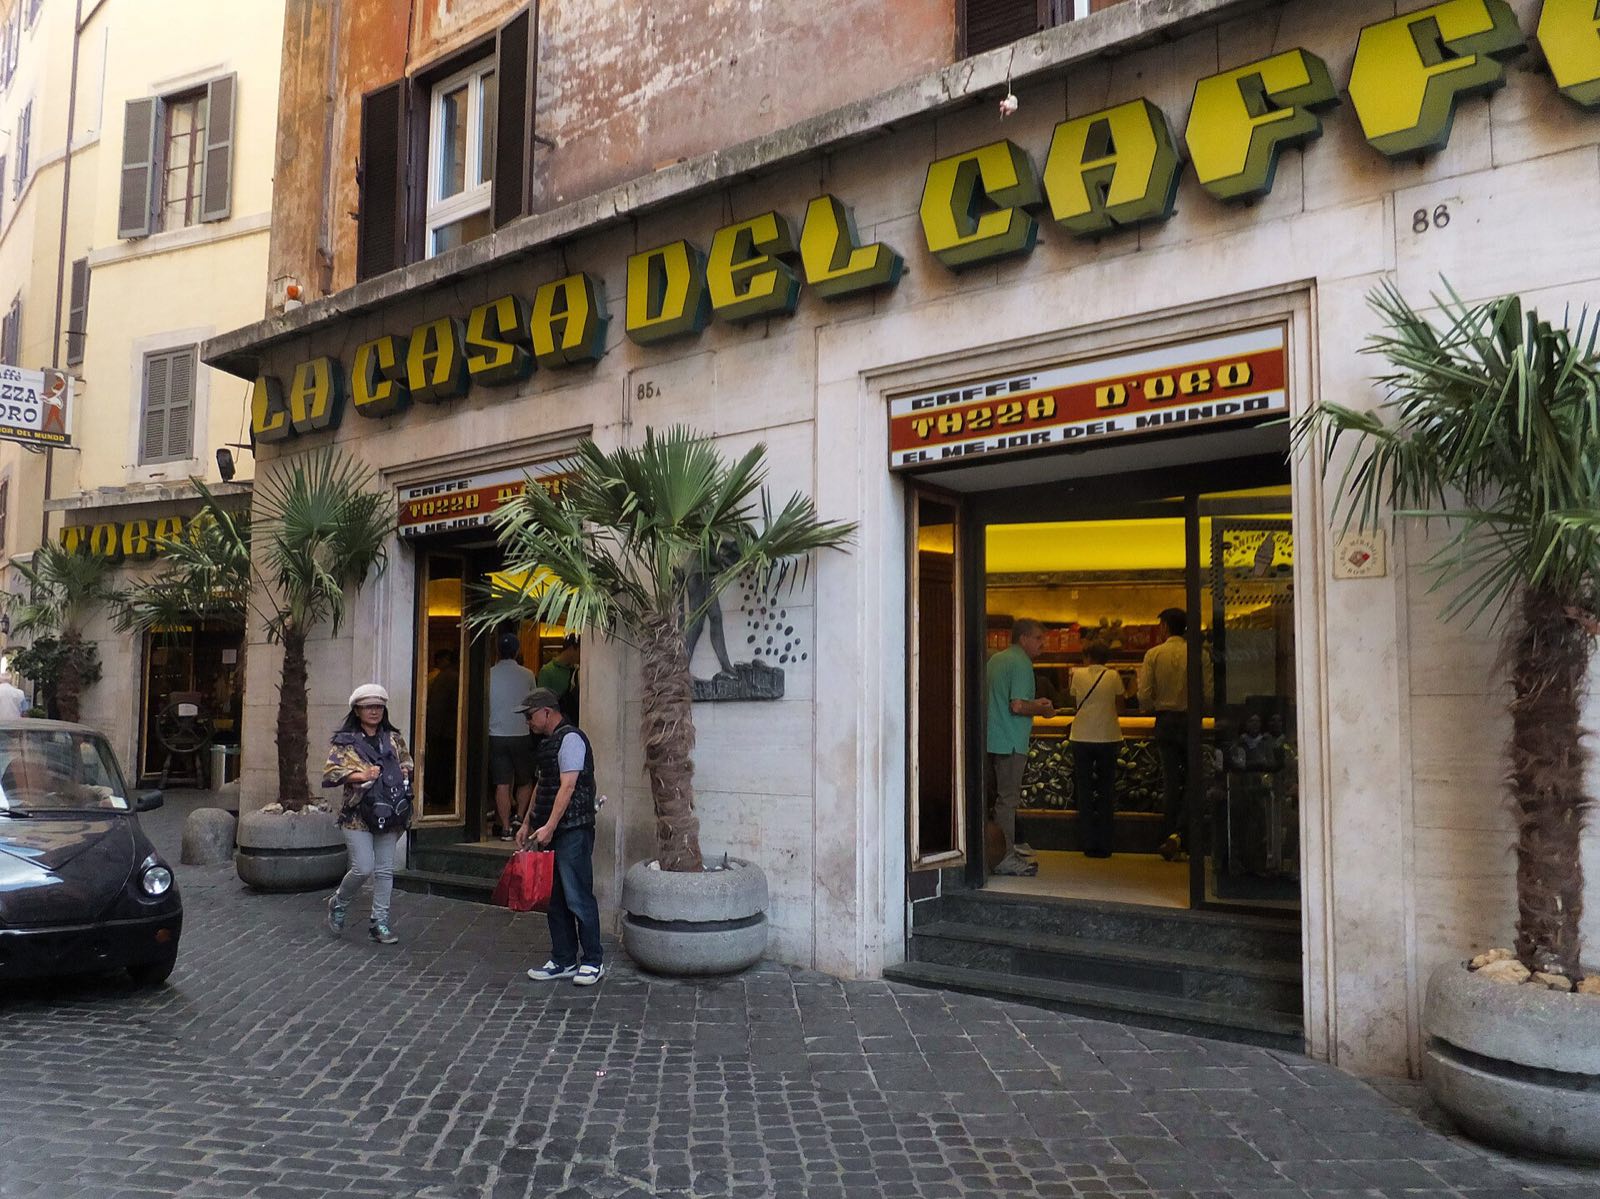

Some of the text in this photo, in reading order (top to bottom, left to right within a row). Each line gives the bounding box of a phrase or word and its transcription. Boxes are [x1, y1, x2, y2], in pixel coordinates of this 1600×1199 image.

[1412, 204, 1450, 233] 86
[251, 355, 336, 436] LA
[351, 272, 592, 407] CASA
[626, 194, 884, 332] DEL
[1, 384, 39, 405] ZZA
[911, 361, 1254, 440] TAZZA D'ORO
[34, 432, 66, 442] MUNDO
[902, 396, 1270, 465] EL MEJOR DEL MUNDO
[409, 493, 480, 518] TAZZA
[425, 516, 480, 534] MEJOR
